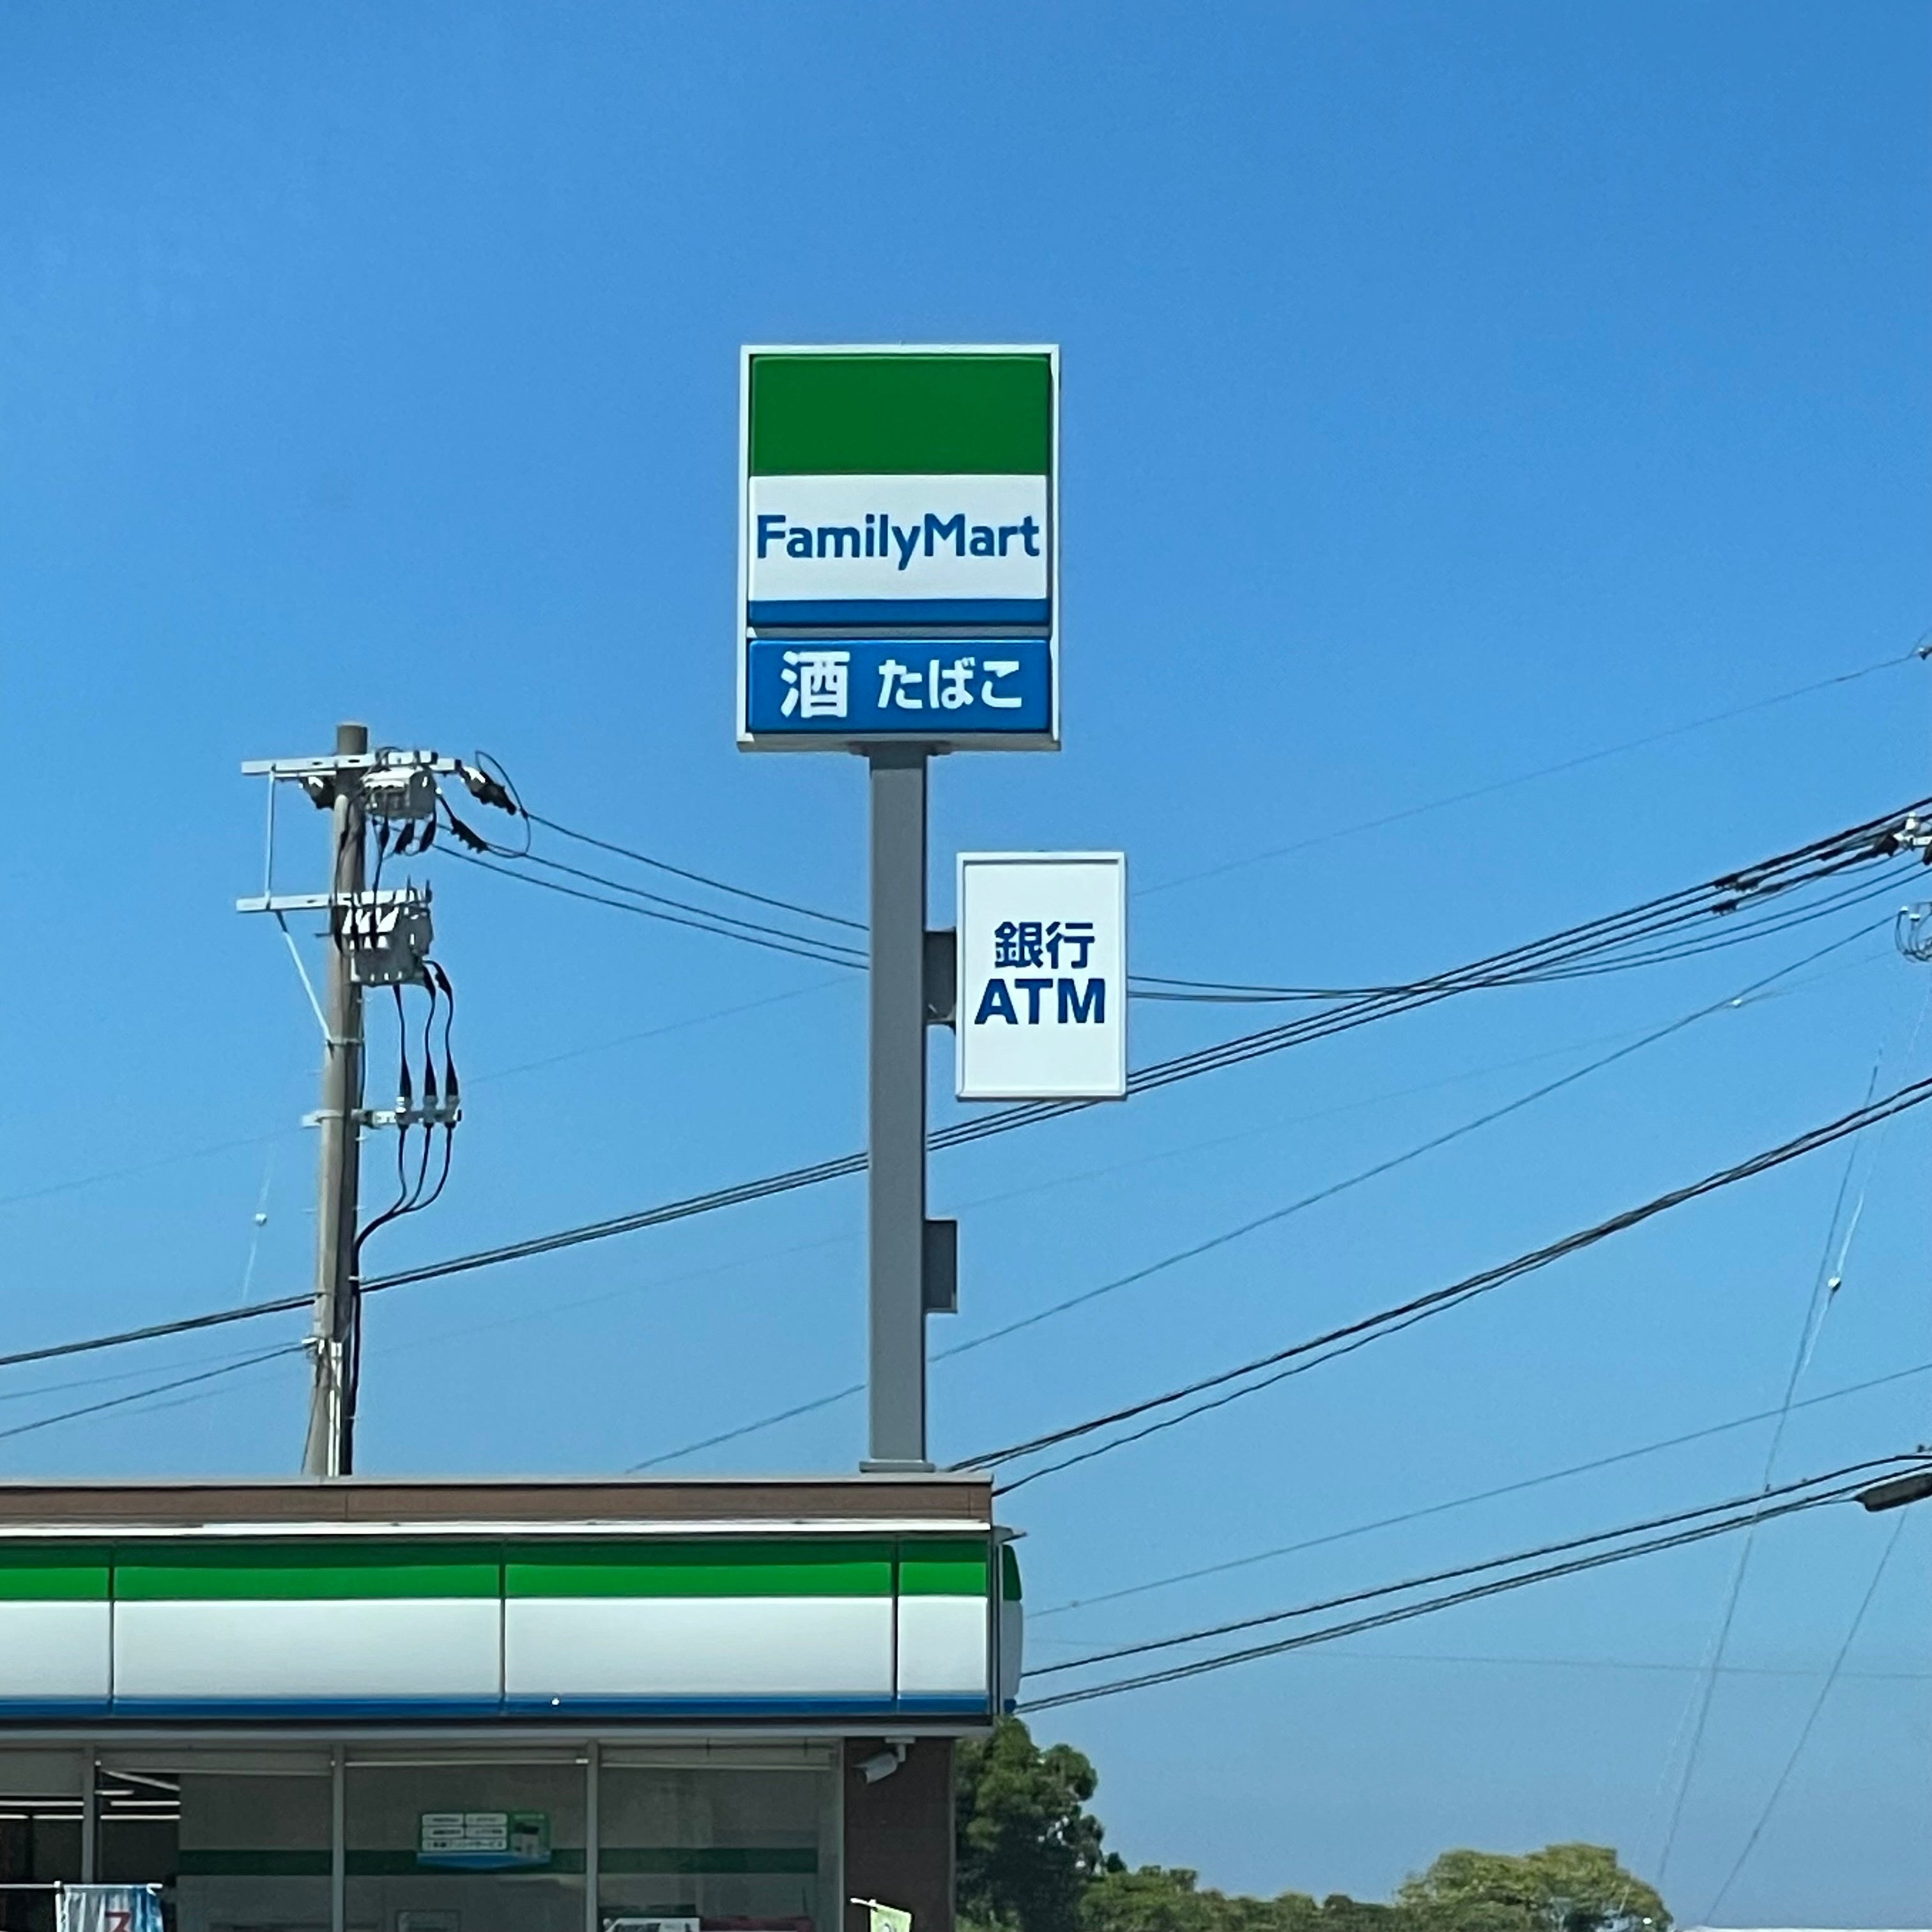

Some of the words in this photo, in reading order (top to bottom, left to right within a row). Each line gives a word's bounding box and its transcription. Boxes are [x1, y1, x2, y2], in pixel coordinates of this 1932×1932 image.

[757, 513, 1040, 571] FamilyMart
[780, 651, 850, 718] 酒
[877, 657, 1022, 710] たばこ
[994, 921, 1096, 970] 銀行
[974, 977, 1106, 1025] ATM
